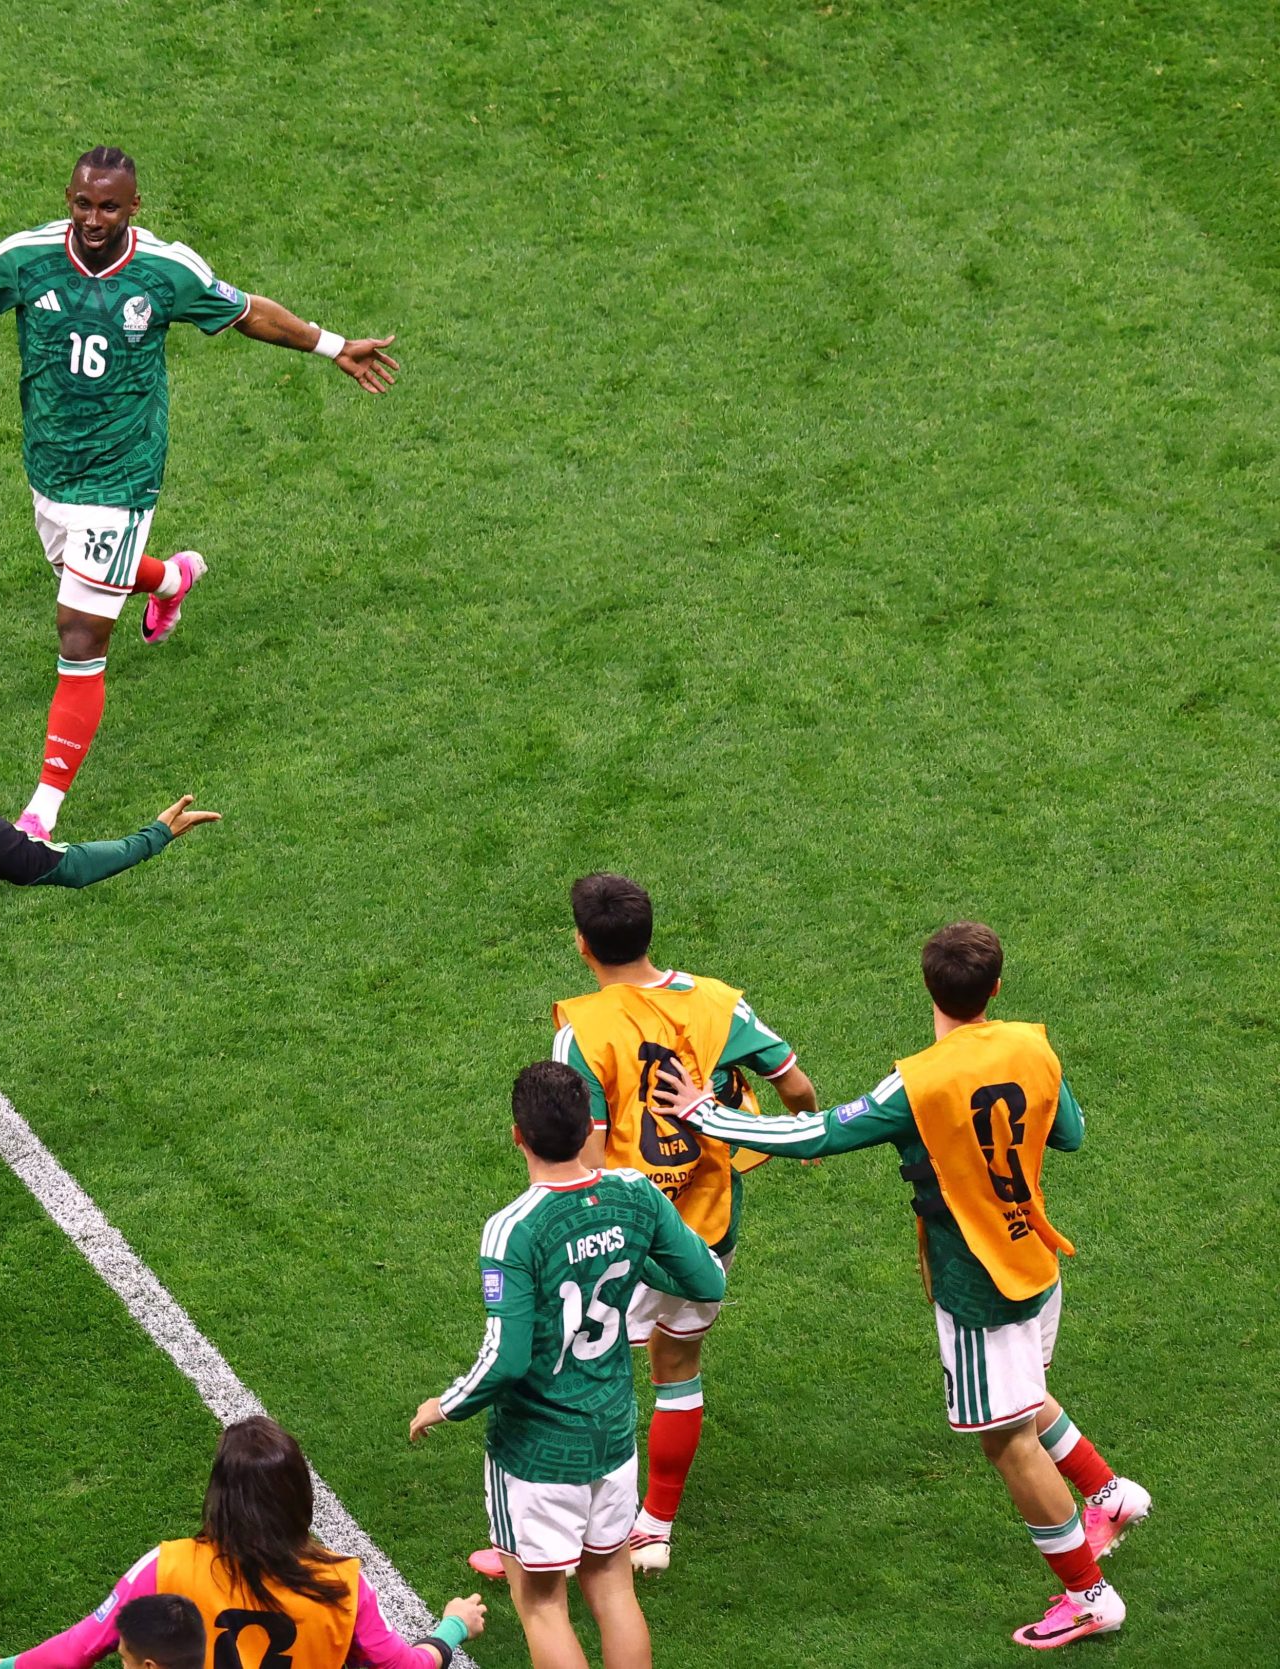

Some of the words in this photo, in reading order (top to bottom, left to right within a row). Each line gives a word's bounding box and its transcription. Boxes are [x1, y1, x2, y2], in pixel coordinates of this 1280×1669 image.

[69, 331, 108, 378] 16
[84, 528, 118, 564] 16
[565, 1225, 626, 1266] I.REYES
[552, 1259, 631, 1376] 15
